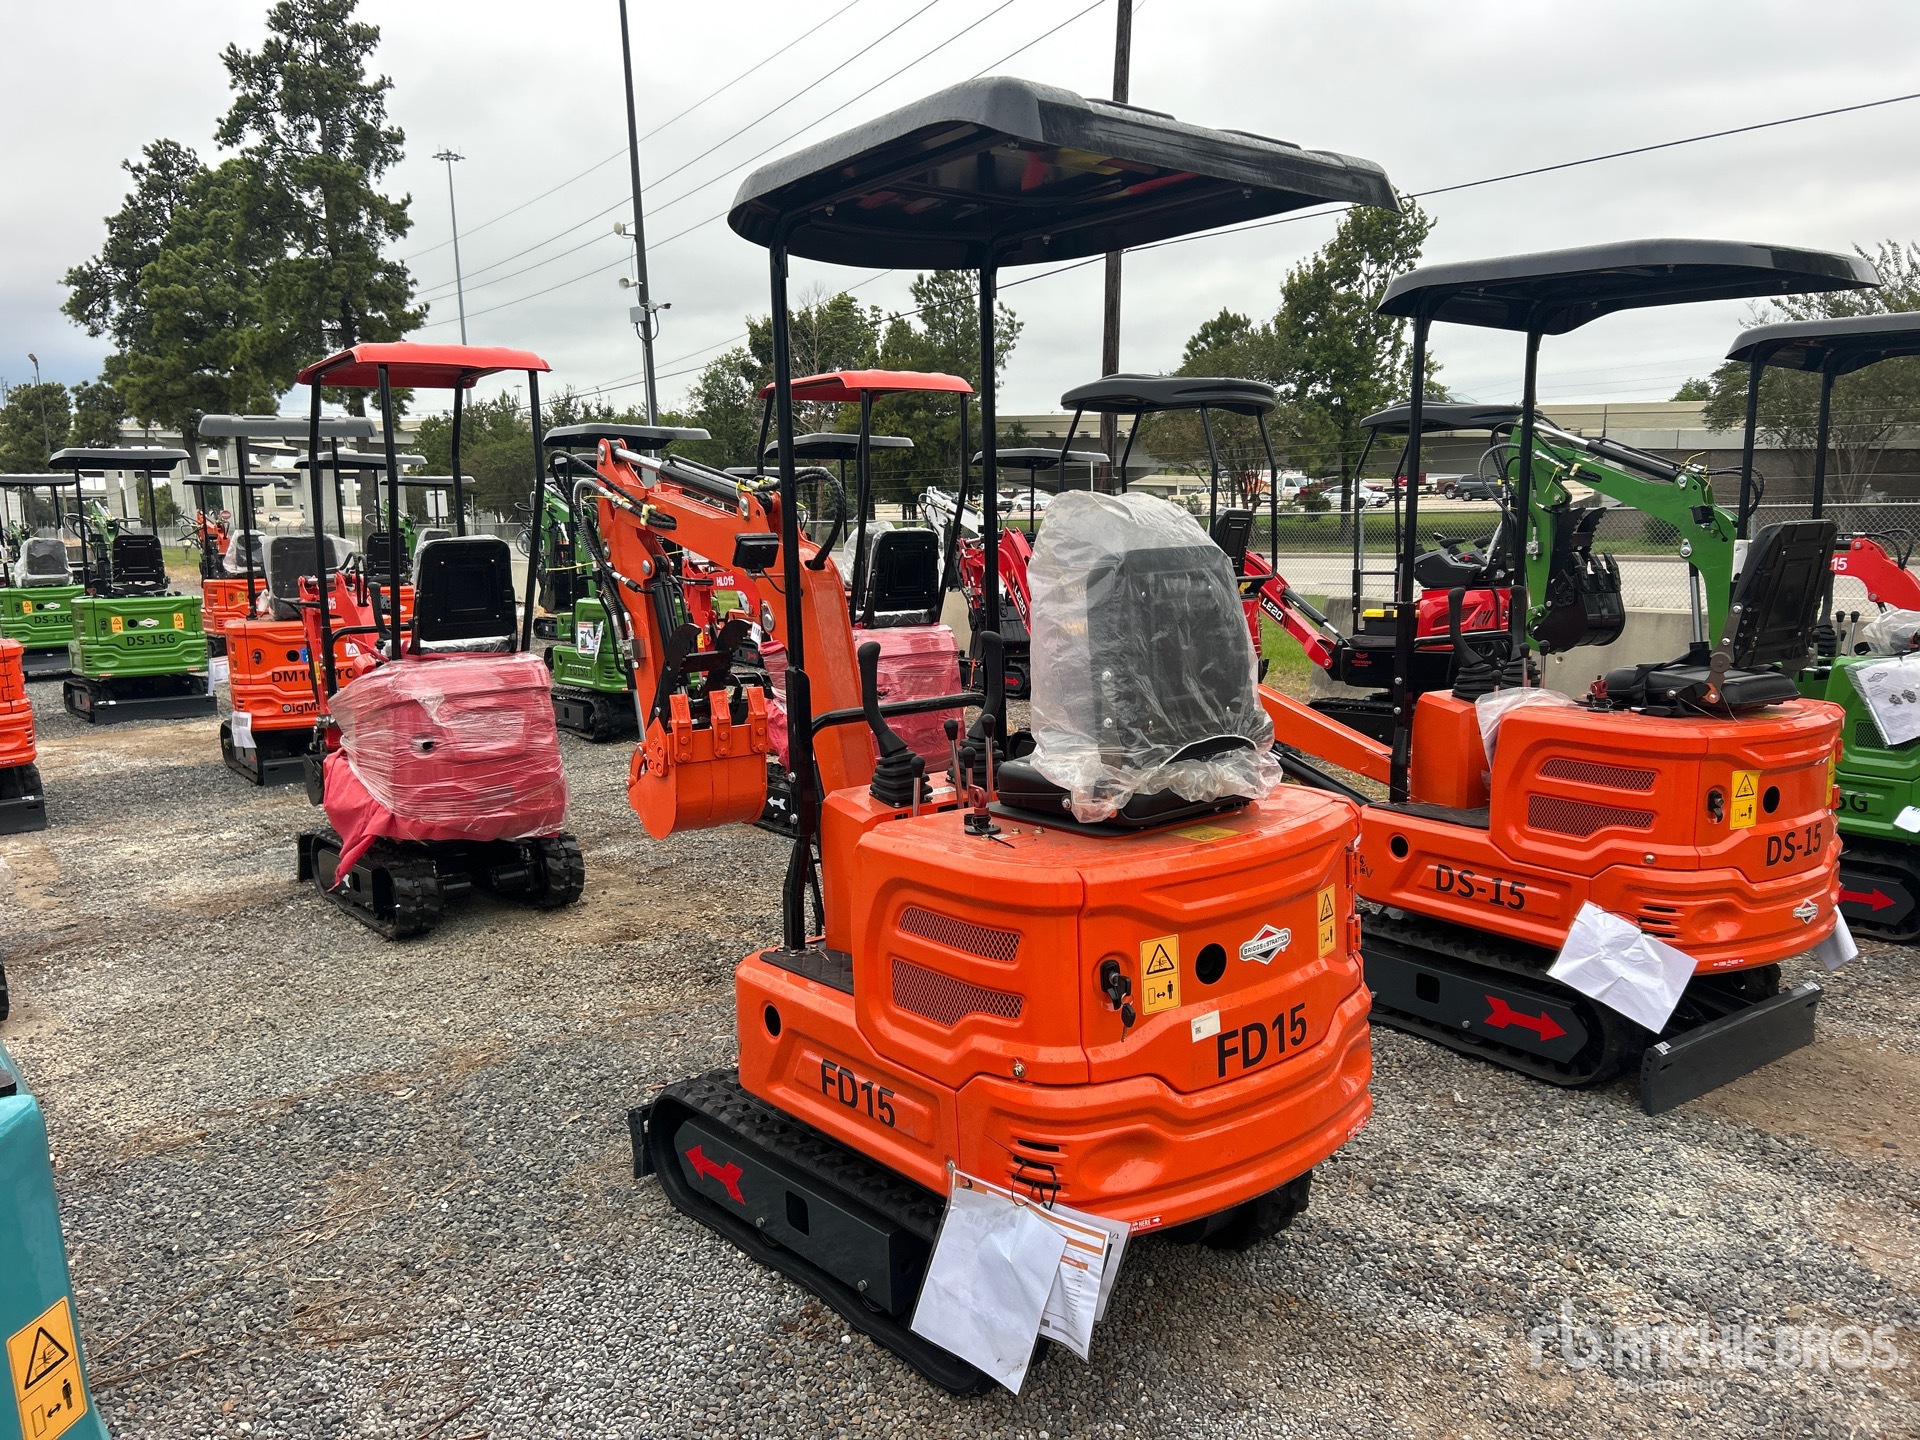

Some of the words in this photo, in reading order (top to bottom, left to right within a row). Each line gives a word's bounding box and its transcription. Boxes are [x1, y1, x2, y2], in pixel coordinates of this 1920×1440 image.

[1831, 557, 1847, 571] 15
[1261, 597, 1284, 620] LE20
[126, 633, 176, 646] DS-15G
[1766, 822, 1822, 867] DS-15
[1435, 863, 1526, 910] DS-15
[1217, 1002, 1307, 1079] FD15
[820, 1058, 895, 1128] FD15
